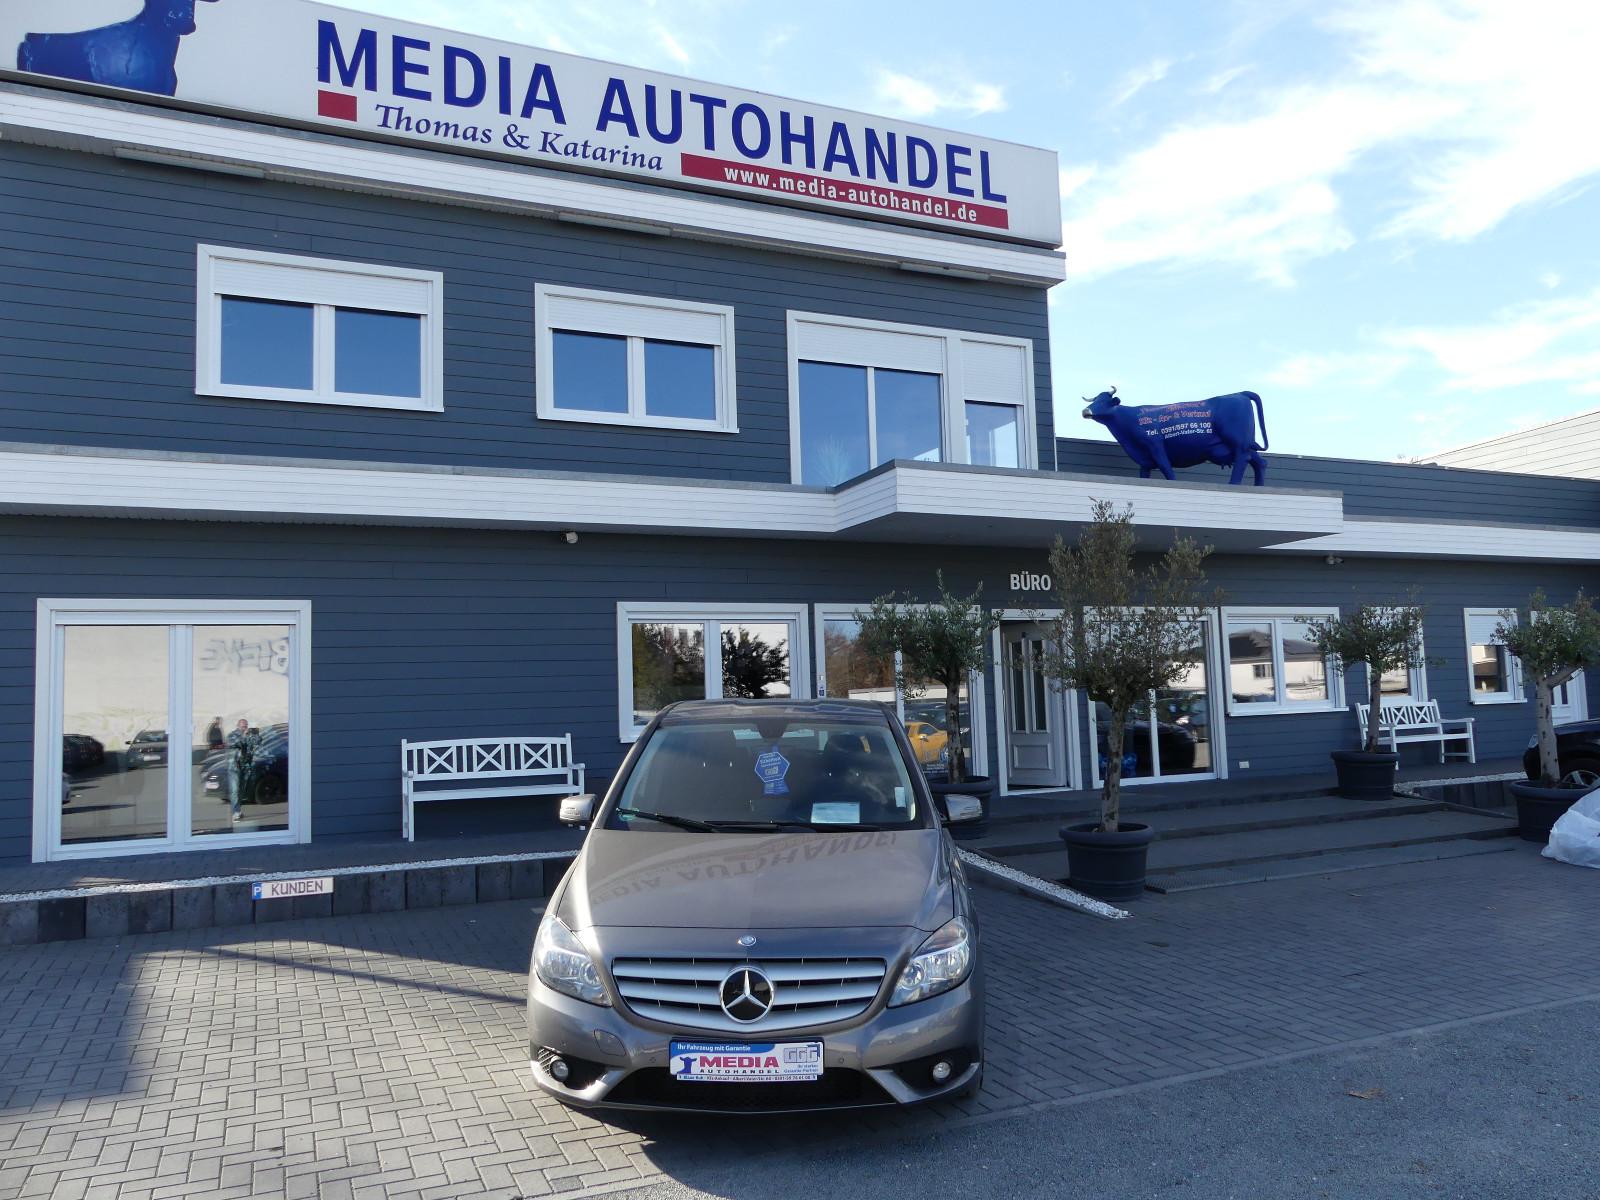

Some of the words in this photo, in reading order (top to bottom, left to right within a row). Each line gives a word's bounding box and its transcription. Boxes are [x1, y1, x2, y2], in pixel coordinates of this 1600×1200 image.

[316, 20, 566, 125] MEDIA
[597, 77, 1008, 204] AUTOHANDEL
[375, 103, 493, 145] Thomas
[503, 123, 531, 151] &
[538, 131, 664, 172] Katarina
[723, 164, 979, 224] www.media-autohandel.de
[1200, 421, 1212, 429] 100
[1010, 570, 1051, 591] BÜRO
[271, 880, 324, 897] KUNDEN
[677, 1043, 687, 1051] Ihr
[687, 1044, 714, 1053] Fahrzeug
[699, 1055, 780, 1068] MEDIA
